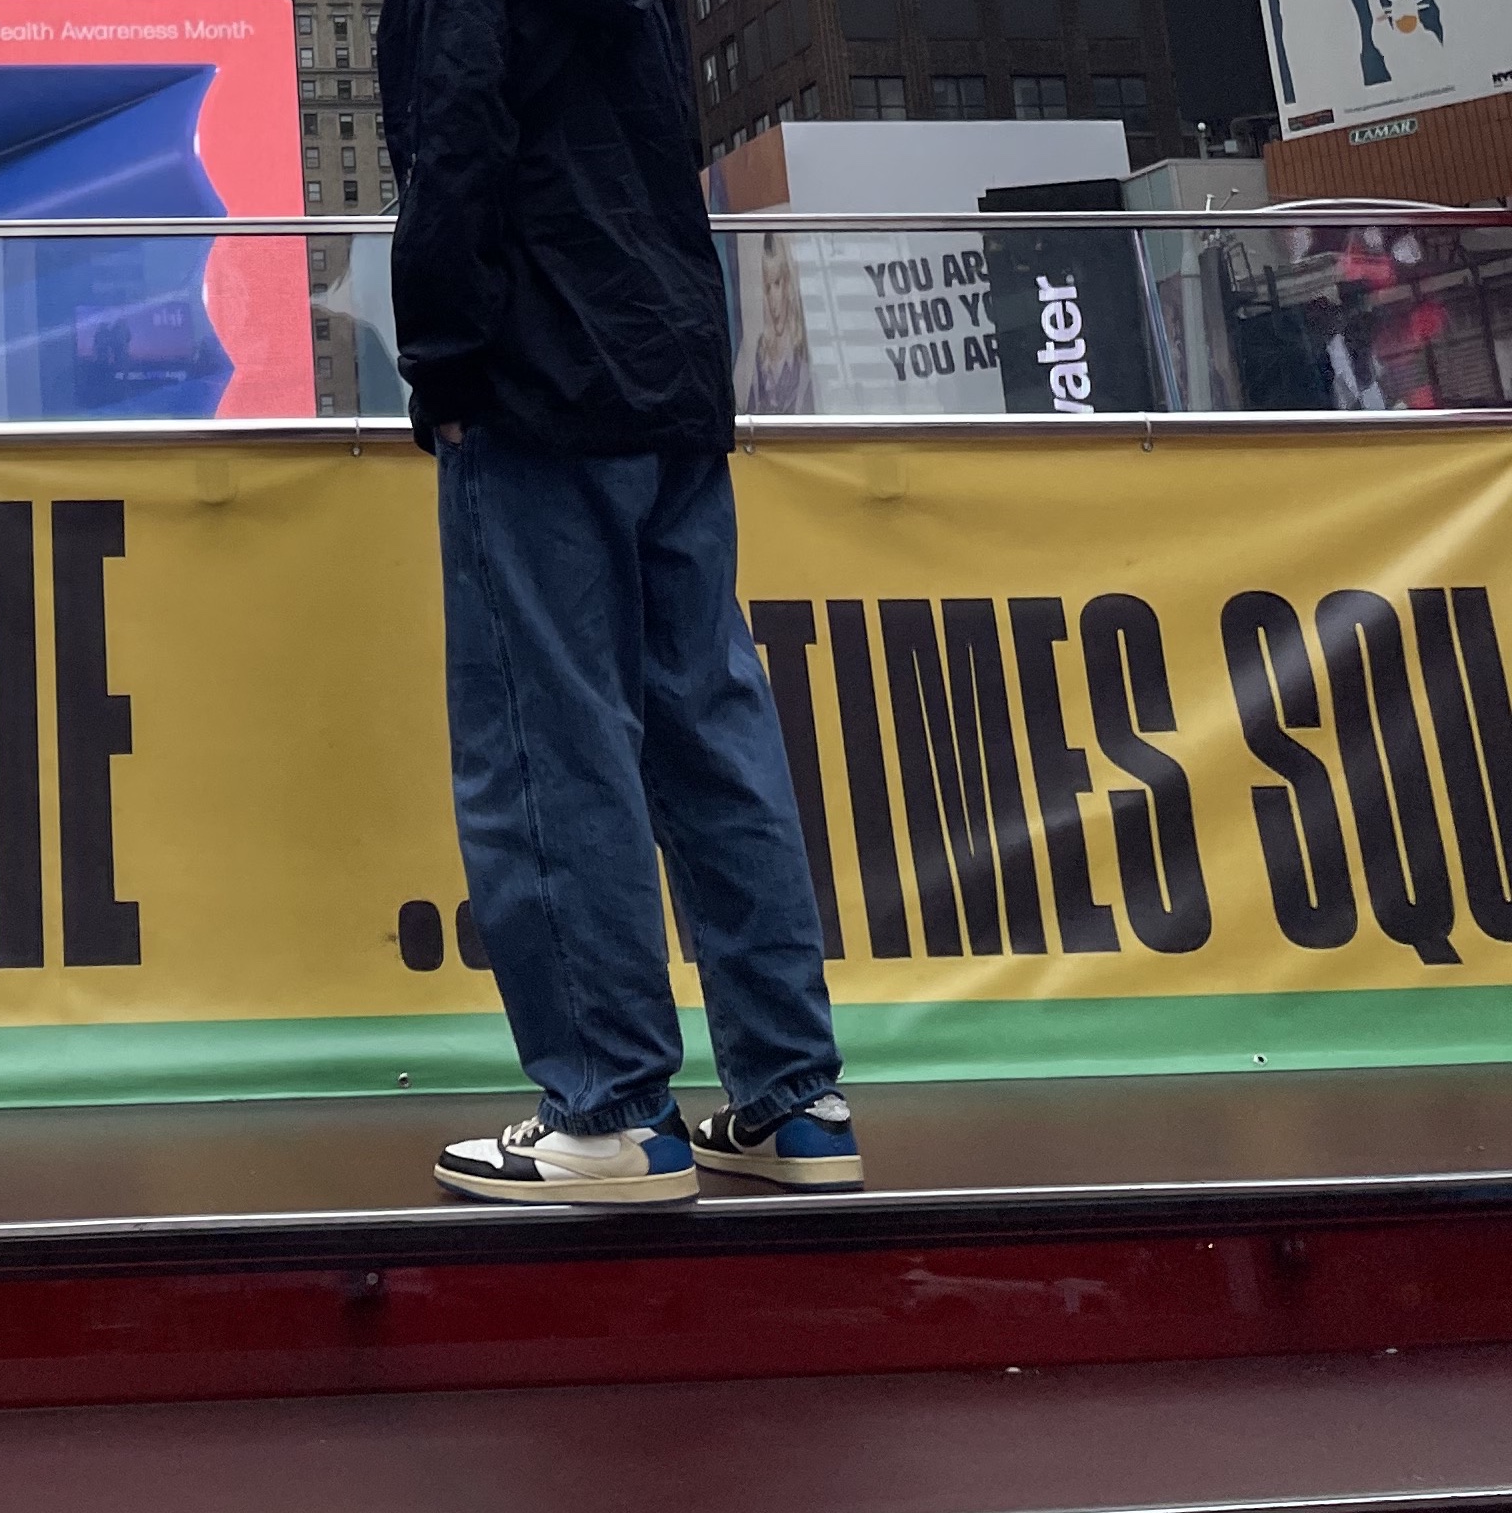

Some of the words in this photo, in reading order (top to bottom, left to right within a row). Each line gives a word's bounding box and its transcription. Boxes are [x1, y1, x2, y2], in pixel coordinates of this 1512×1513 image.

[61, 21, 178, 42] Awareness
[184, 21, 253, 41] Month
[1354, 120, 1412, 143] LAMAR
[864, 257, 935, 298] YOU
[874, 297, 954, 340] WHO
[885, 340, 956, 381] YOU
[1221, 586, 1512, 965] SQU
